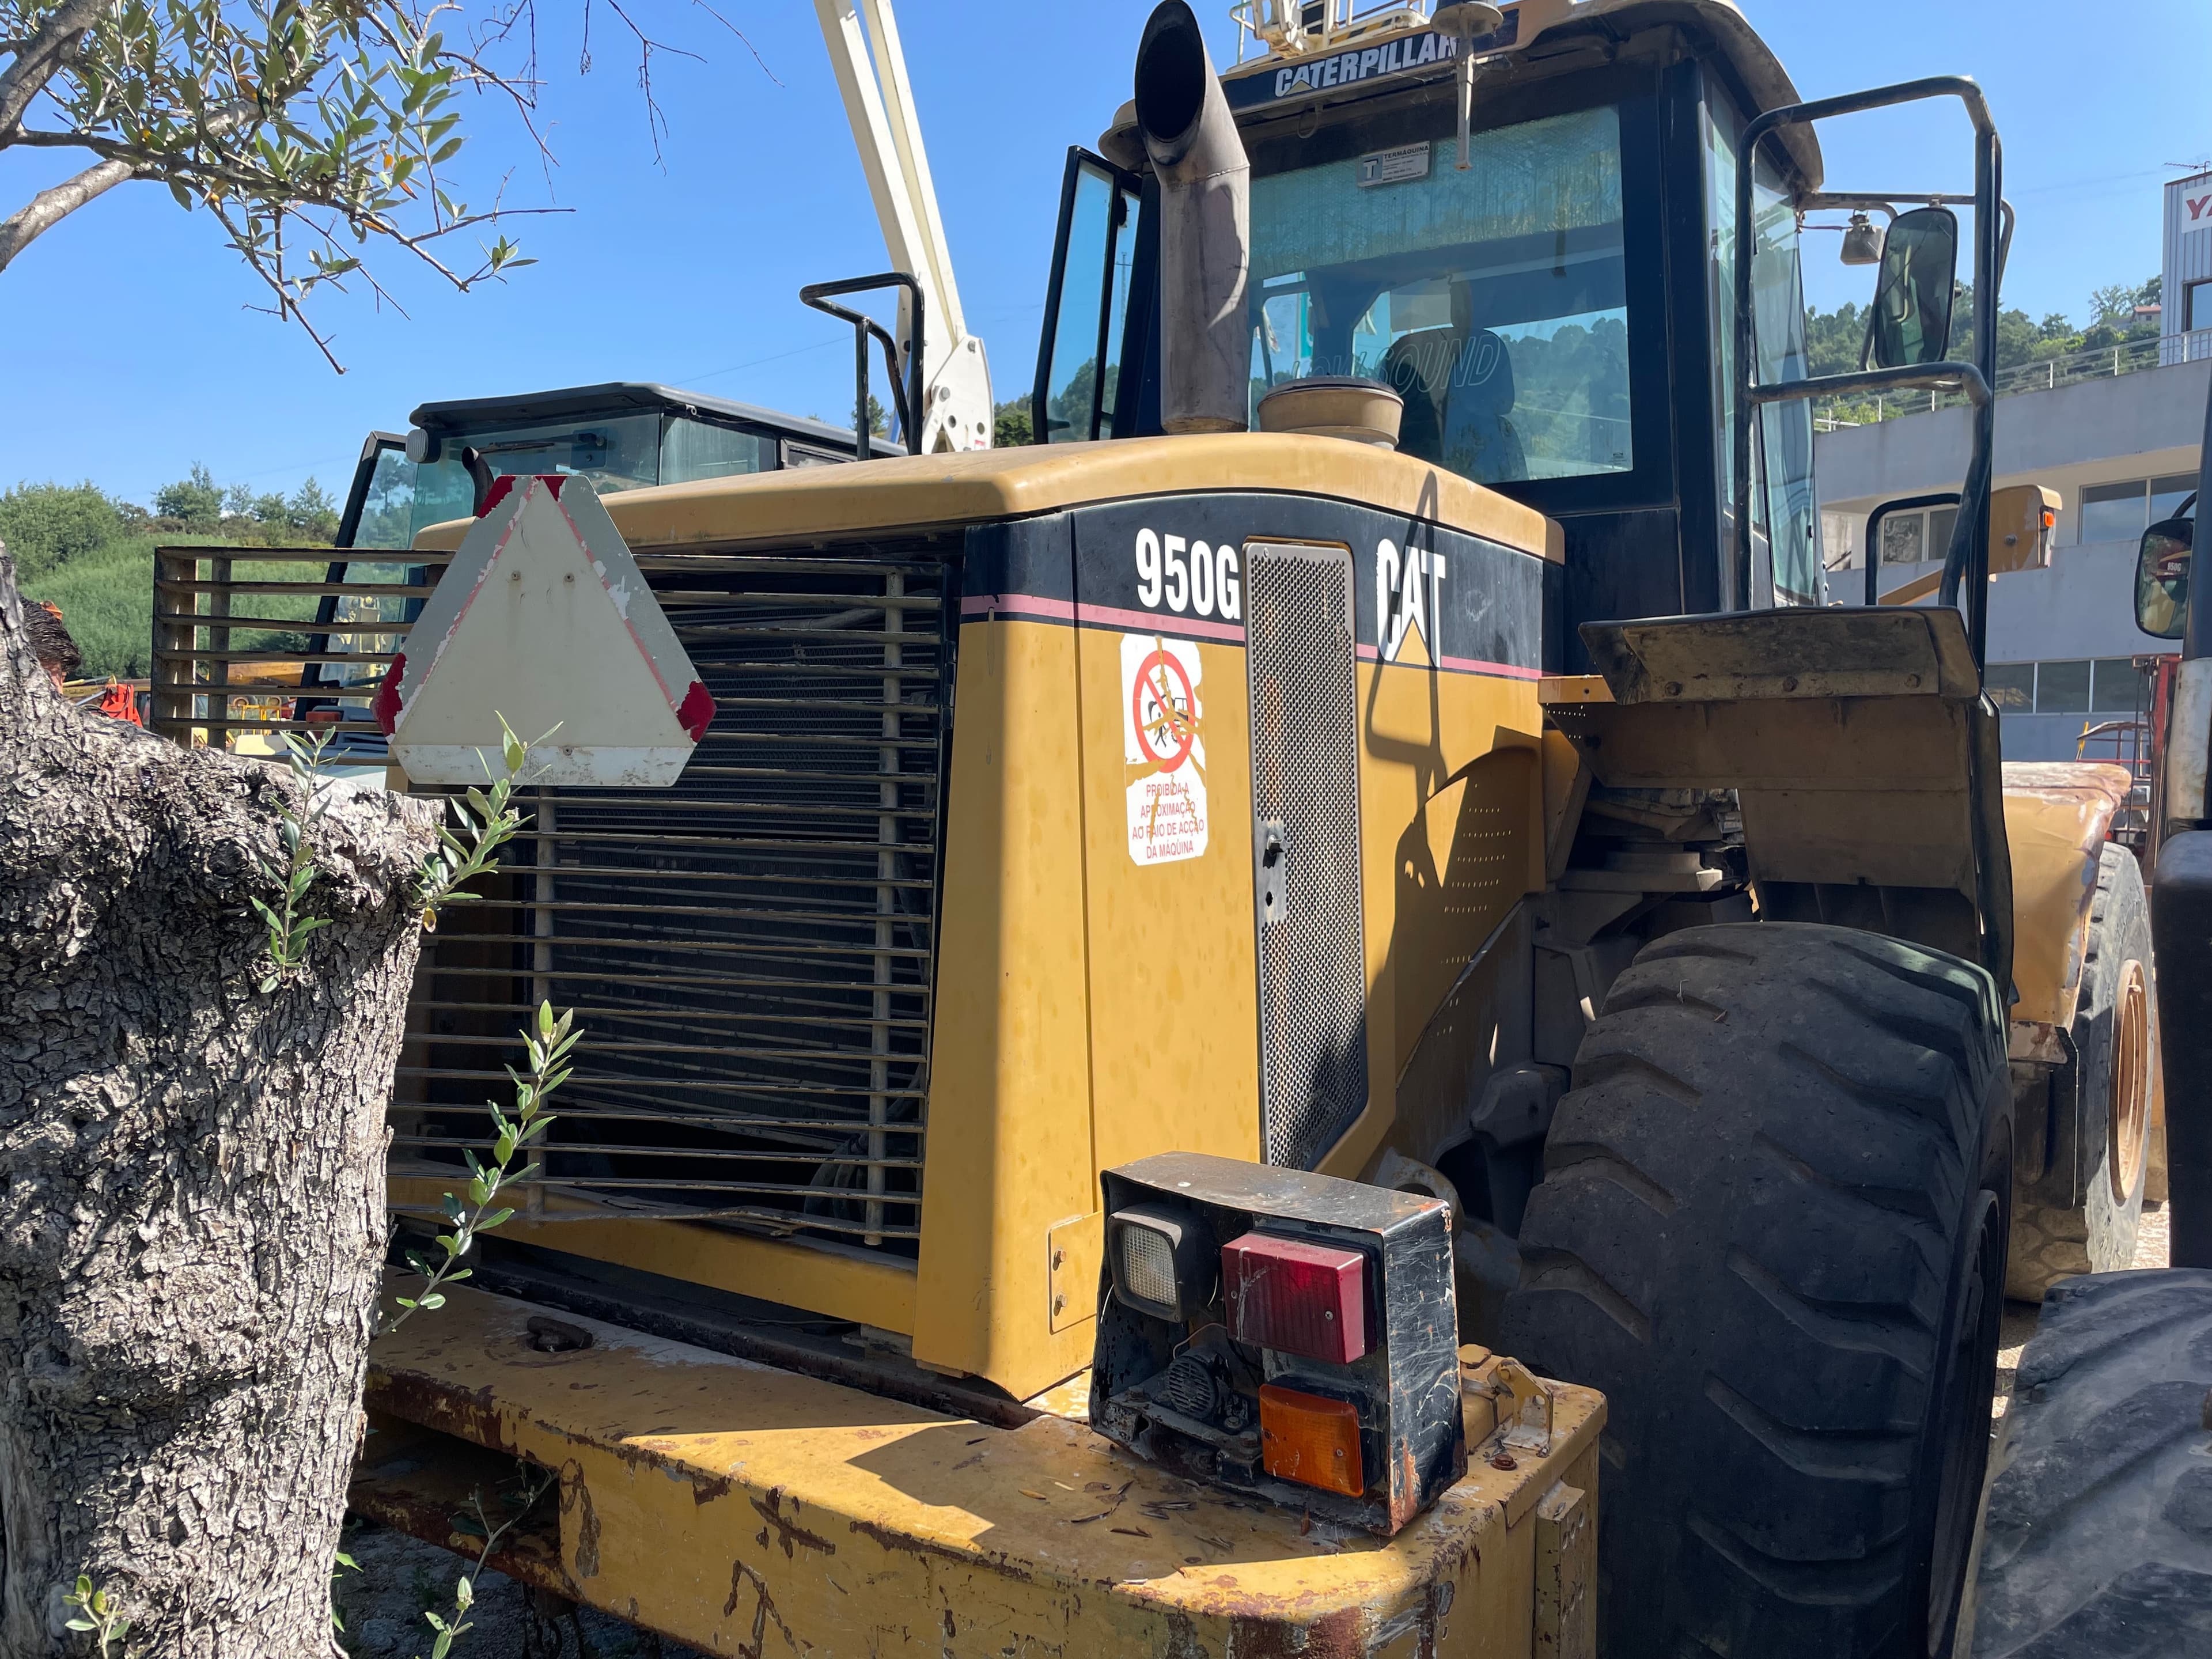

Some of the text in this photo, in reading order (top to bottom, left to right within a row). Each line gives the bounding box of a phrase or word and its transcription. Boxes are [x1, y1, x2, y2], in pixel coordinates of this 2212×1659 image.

[1363, 158, 1378, 179] T
[2186, 194, 2212, 221] Y
[1135, 528, 1241, 620] 950G
[1376, 539, 1446, 668] CAT
[1167, 822, 1177, 836] DE
[1146, 845, 1158, 859] DA
